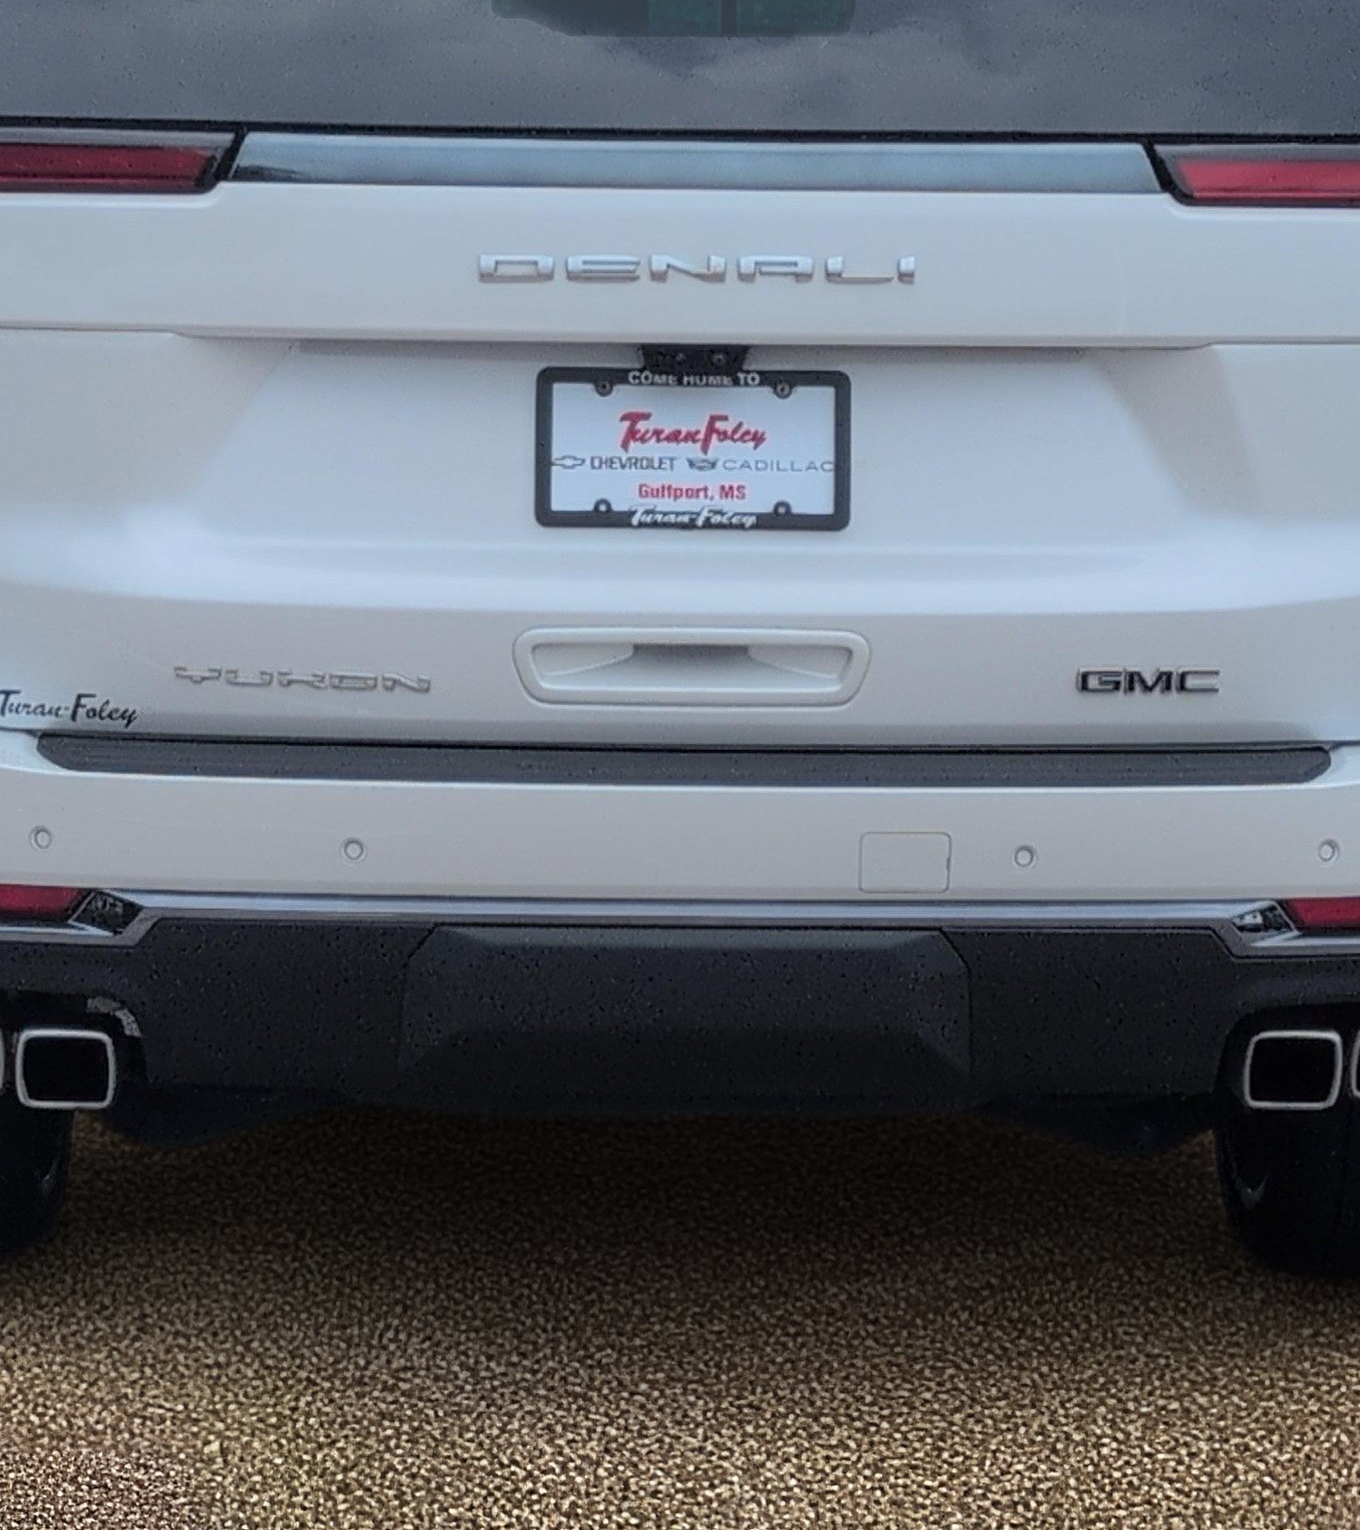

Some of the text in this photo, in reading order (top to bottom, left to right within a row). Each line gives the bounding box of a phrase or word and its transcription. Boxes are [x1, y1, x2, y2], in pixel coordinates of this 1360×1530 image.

[478, 253, 915, 285] DENALI
[737, 371, 761, 386] TO
[590, 455, 835, 472] CHEVROLET CADILLAC
[638, 483, 746, 501] Gulfport, MS
[173, 666, 431, 693] YUKON
[1075, 668, 1220, 695] GMC
